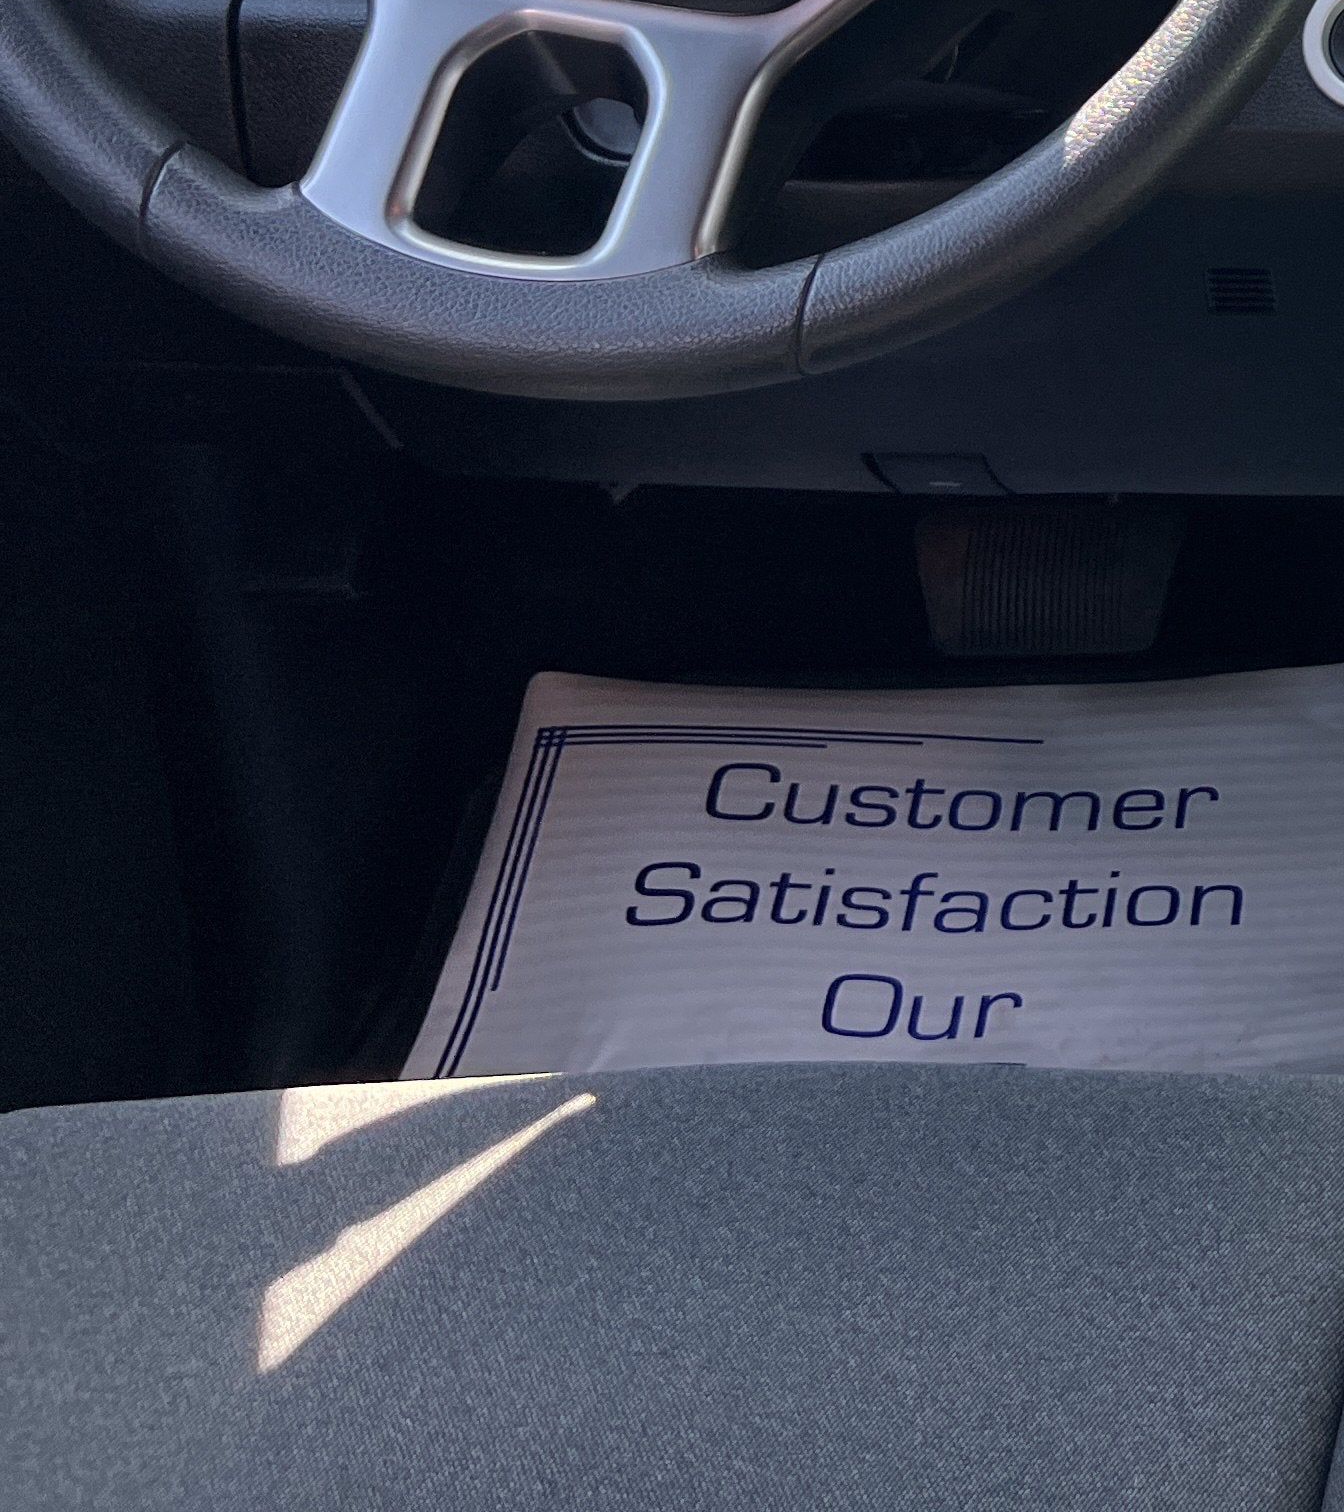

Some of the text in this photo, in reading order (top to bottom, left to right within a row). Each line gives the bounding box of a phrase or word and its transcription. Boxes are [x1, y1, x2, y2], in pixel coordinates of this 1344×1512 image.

[702, 761, 1220, 833] Customer
[624, 860, 1245, 934] Satisfaction
[820, 973, 1023, 1041] Our
